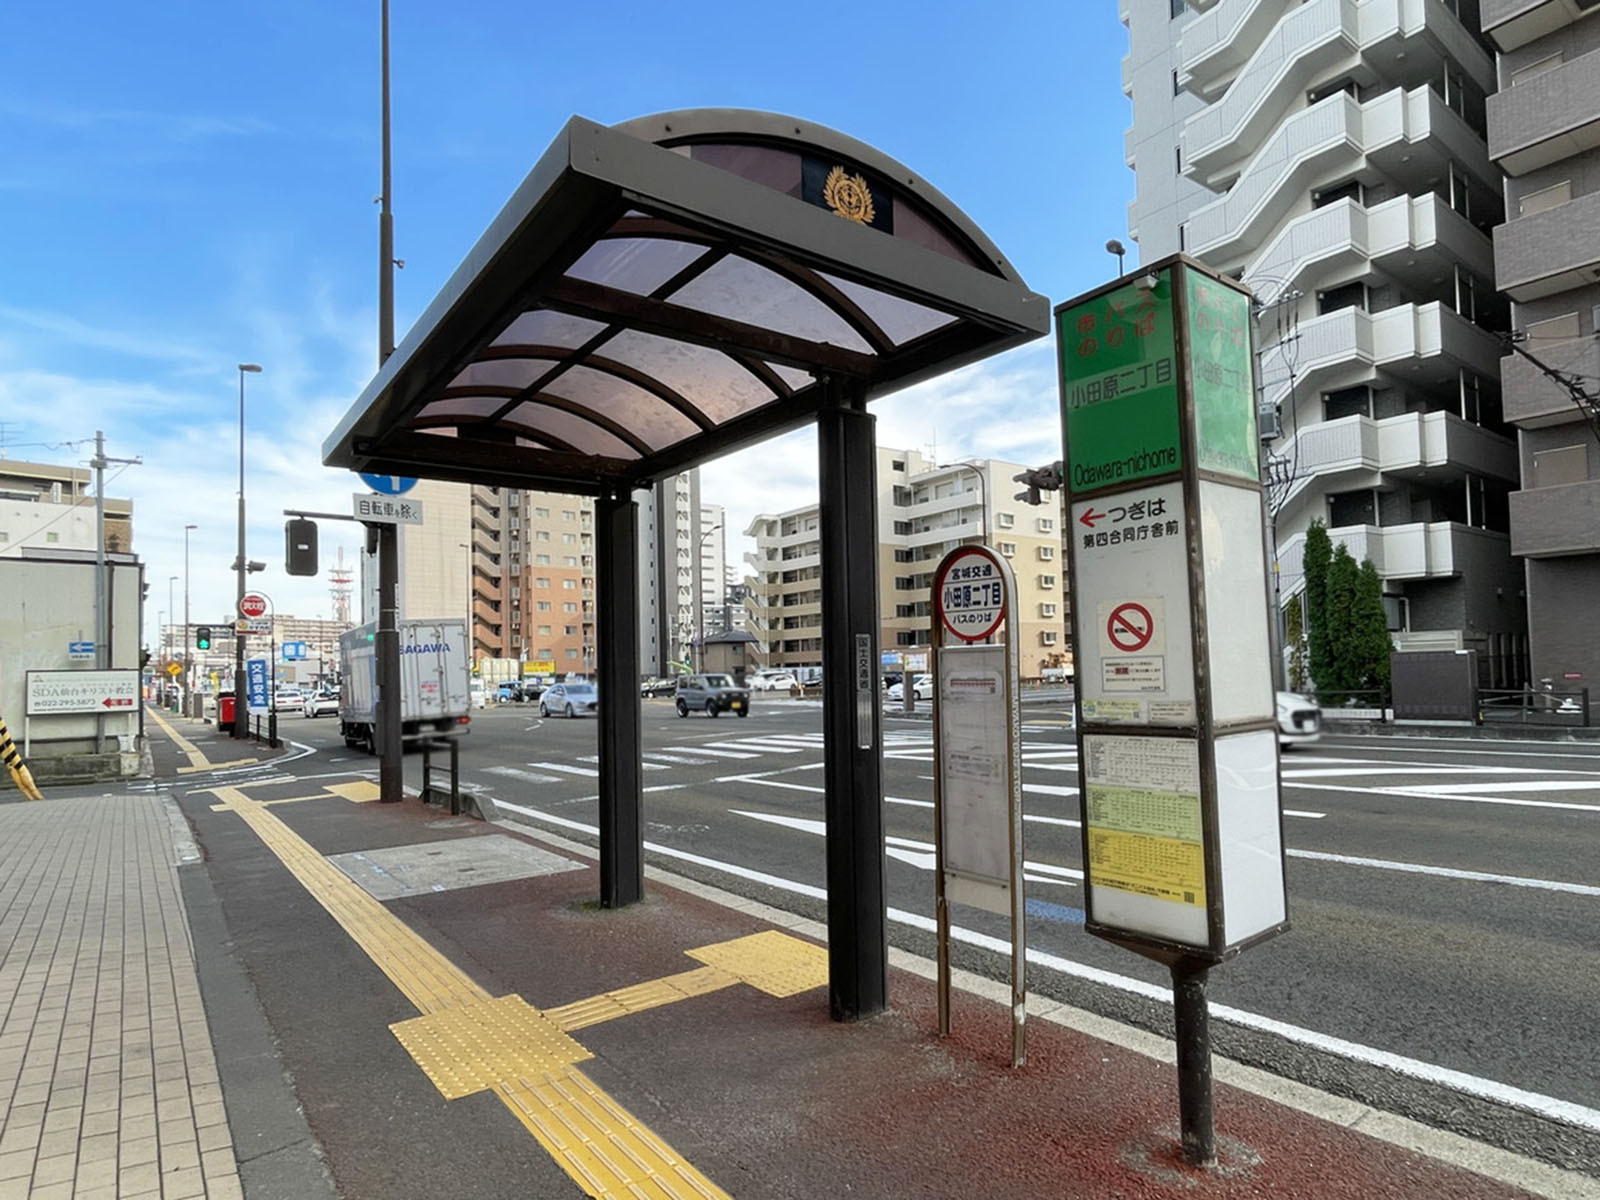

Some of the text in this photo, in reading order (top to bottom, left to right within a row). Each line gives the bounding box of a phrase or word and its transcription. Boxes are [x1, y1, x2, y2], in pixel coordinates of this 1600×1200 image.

[1077, 310, 1158, 358] のりば
[1071, 357, 1172, 409] 小田原二丁目
[1074, 446, 1177, 486] Odawara-nichome
[359, 499, 418, 520] 自転車を除く
[1107, 498, 1167, 523] つぎは
[1083, 520, 1179, 549] 第四合同庁舎前
[951, 564, 992, 580] 宮城交通
[944, 581, 1001, 609] 小田原二丁目
[952, 612, 993, 624] バスのりば
